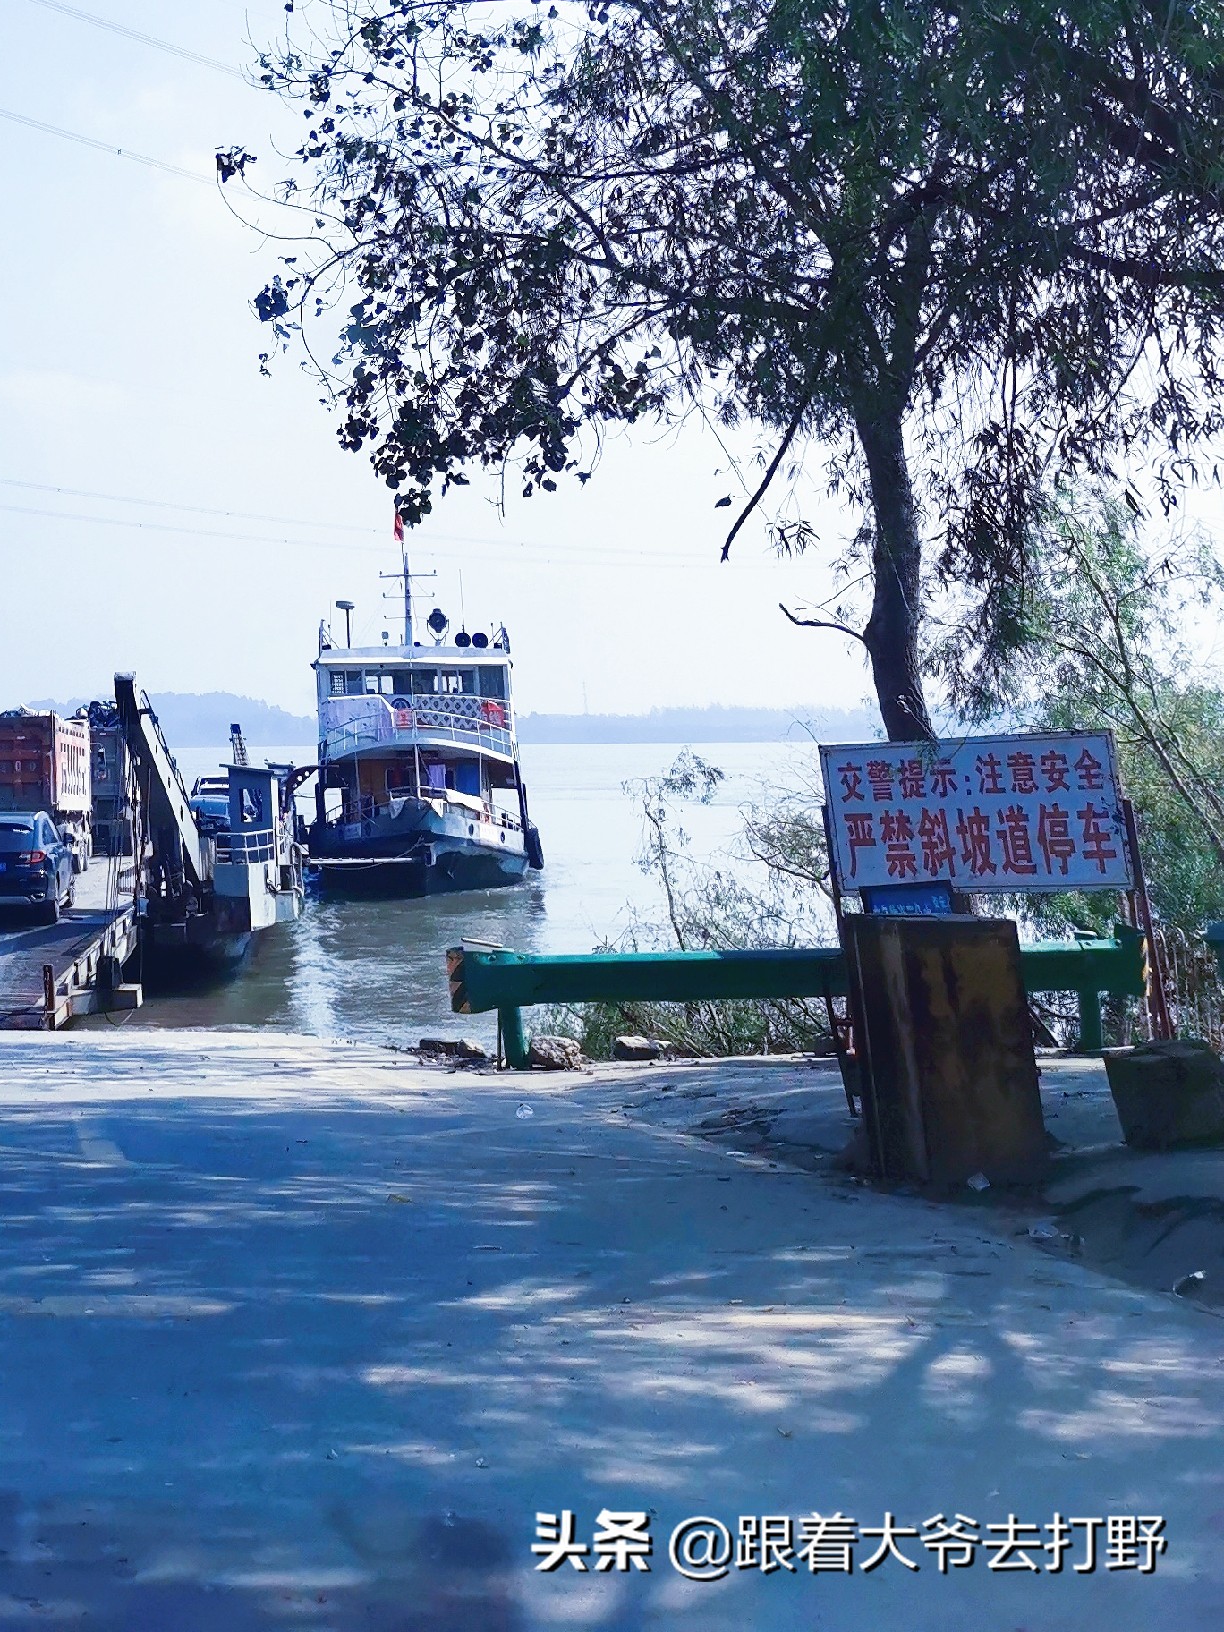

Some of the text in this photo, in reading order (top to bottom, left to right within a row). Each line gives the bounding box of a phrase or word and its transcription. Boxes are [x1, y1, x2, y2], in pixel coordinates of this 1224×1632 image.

[837, 748, 1104, 802] 交警提示:注意安全
[843, 801, 1117, 879] 严禁斜坡道停车
